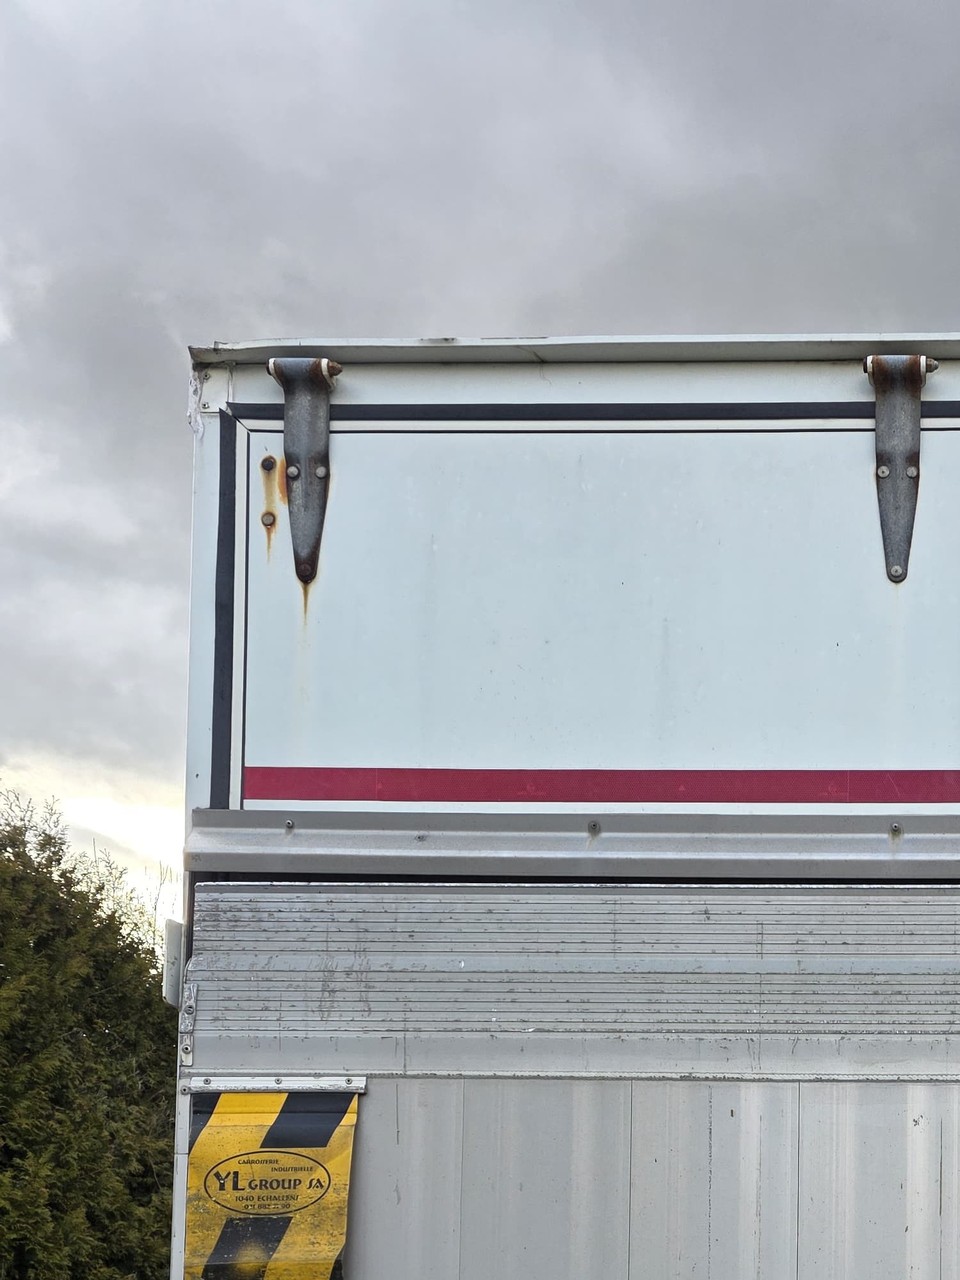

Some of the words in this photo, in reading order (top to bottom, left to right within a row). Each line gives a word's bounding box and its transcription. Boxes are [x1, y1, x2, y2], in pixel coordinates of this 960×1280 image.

[213, 1171, 245, 1191] YL
[248, 1178, 302, 1191] GROUP
[306, 1178, 325, 1190] SA
